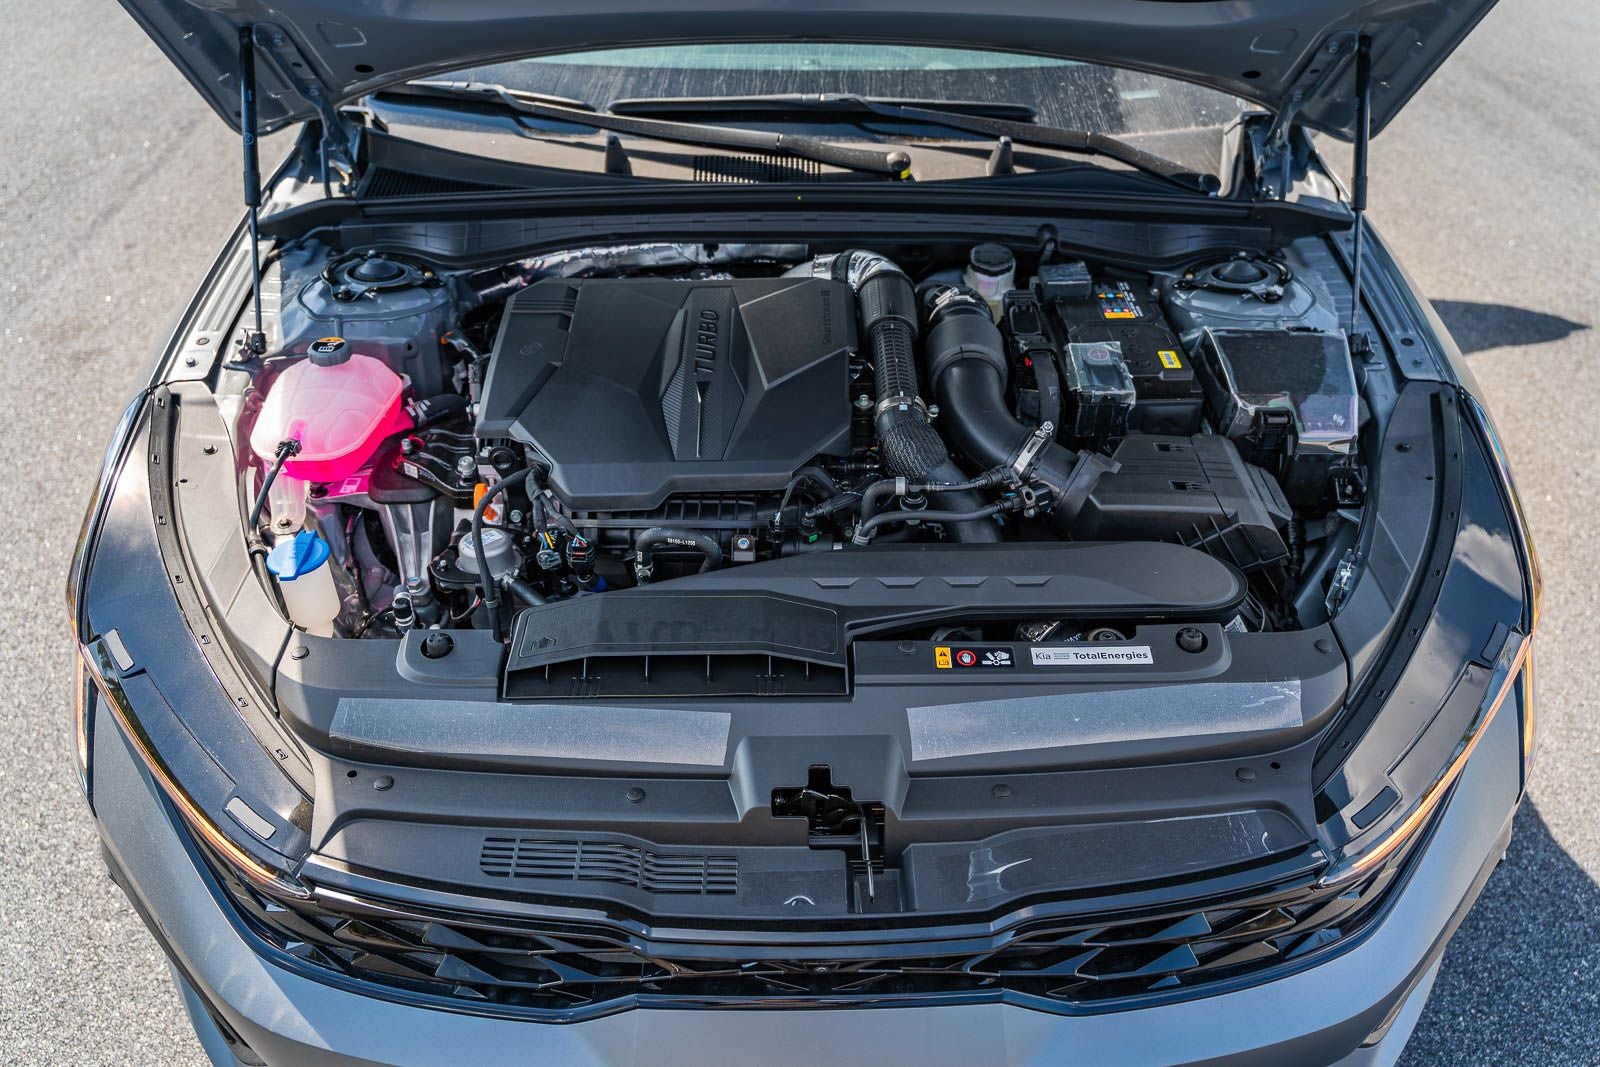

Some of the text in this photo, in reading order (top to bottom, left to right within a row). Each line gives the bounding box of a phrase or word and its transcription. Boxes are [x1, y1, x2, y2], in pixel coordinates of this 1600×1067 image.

[694, 309, 719, 374] TURBO
[1035, 652, 1051, 660] Kia
[1073, 652, 1148, 661] TotalEnergies
